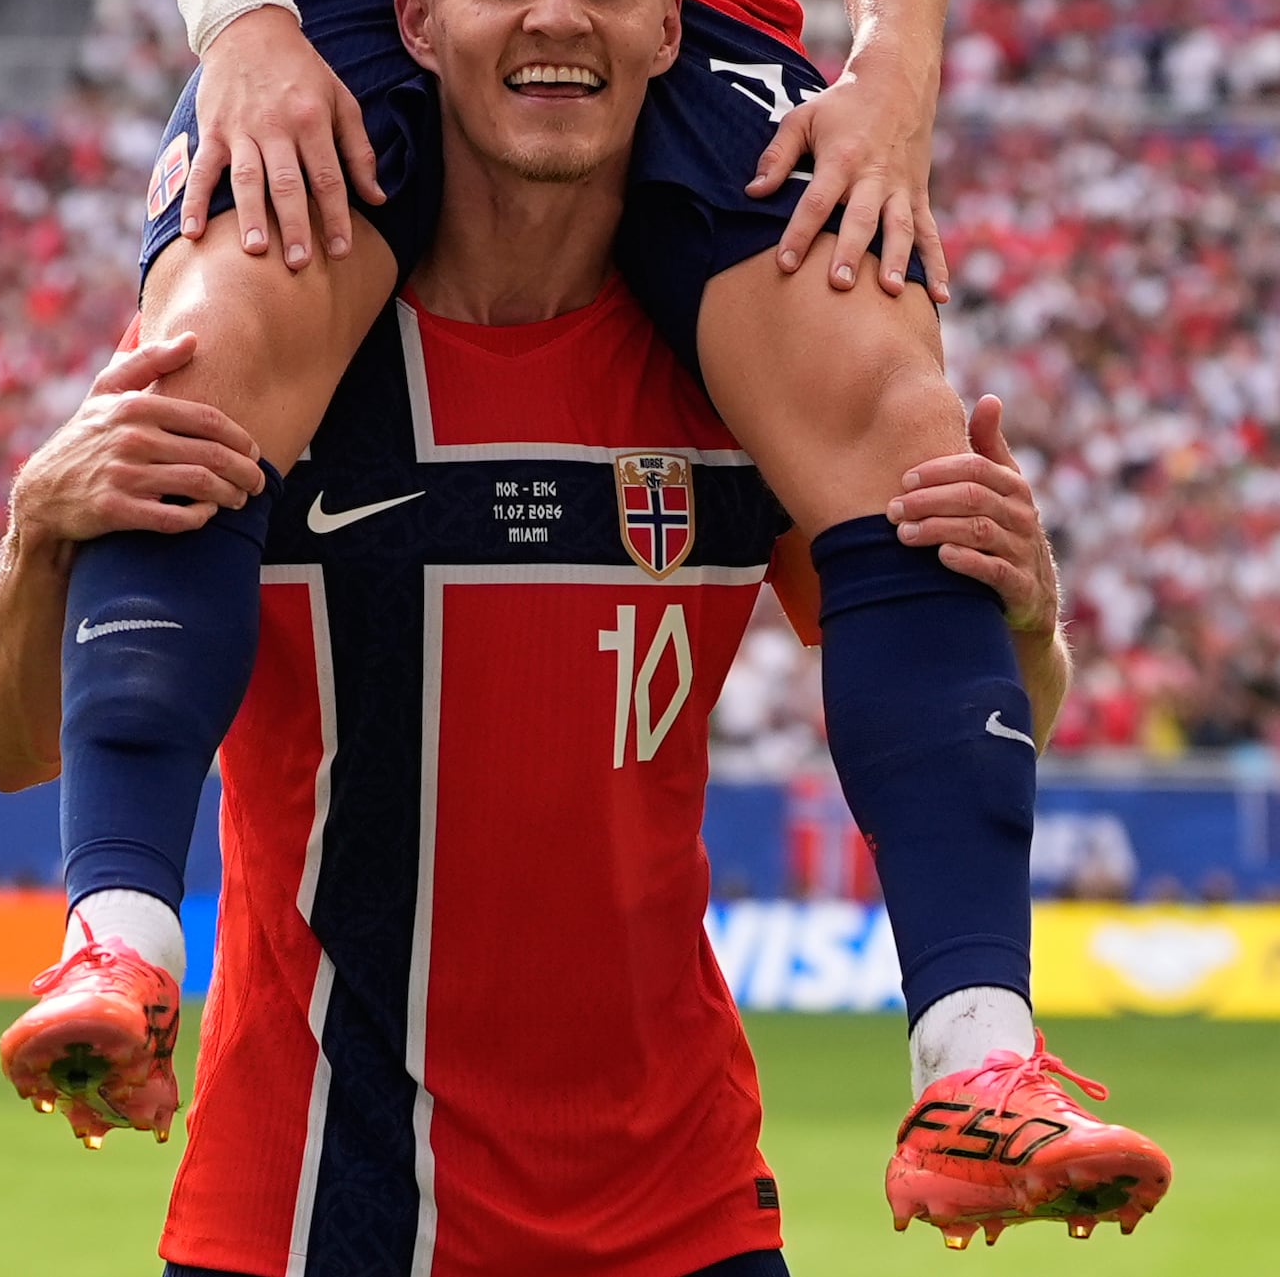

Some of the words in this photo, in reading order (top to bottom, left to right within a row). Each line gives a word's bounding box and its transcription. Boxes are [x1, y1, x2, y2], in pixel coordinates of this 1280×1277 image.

[495, 481, 519, 497] NOR
[532, 481, 557, 497] ENG
[492, 504, 563, 520] 11.07.2026
[508, 527, 548, 543] MIAMI
[598, 603, 694, 770] 10
[896, 1100, 1071, 1167] F50
